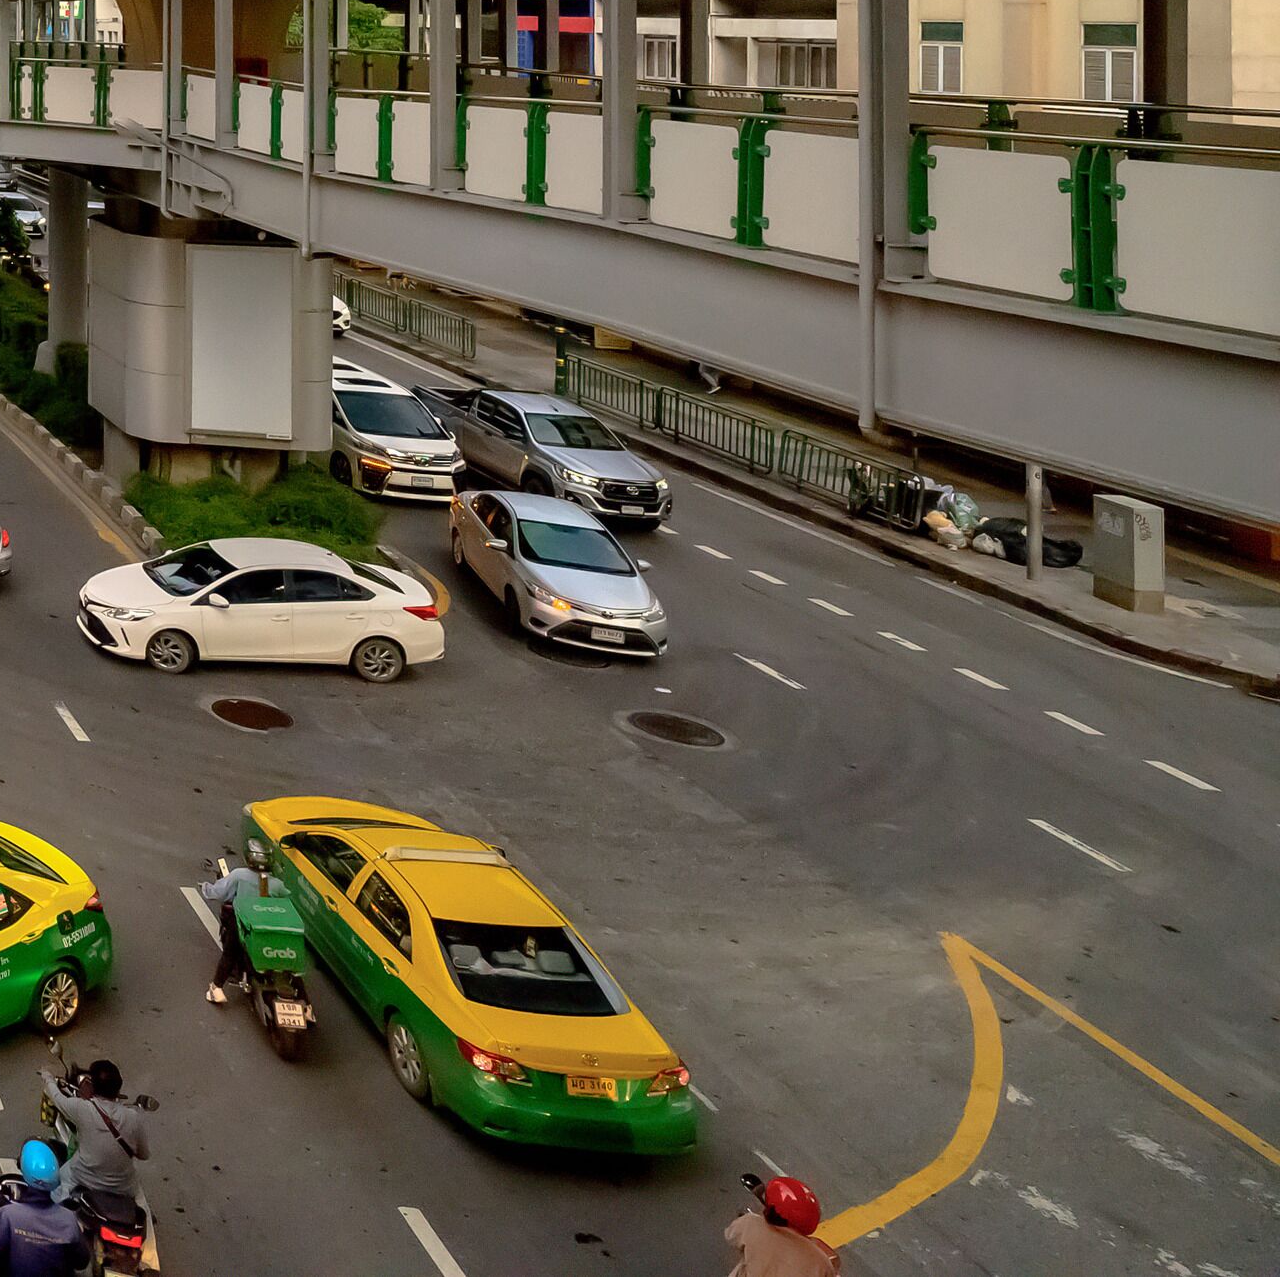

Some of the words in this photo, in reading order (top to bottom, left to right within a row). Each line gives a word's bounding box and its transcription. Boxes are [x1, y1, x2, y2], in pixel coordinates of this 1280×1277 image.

[252, 904, 287, 913] Grab
[262, 946, 297, 959] Grab
[589, 1080, 613, 1091] 3140
